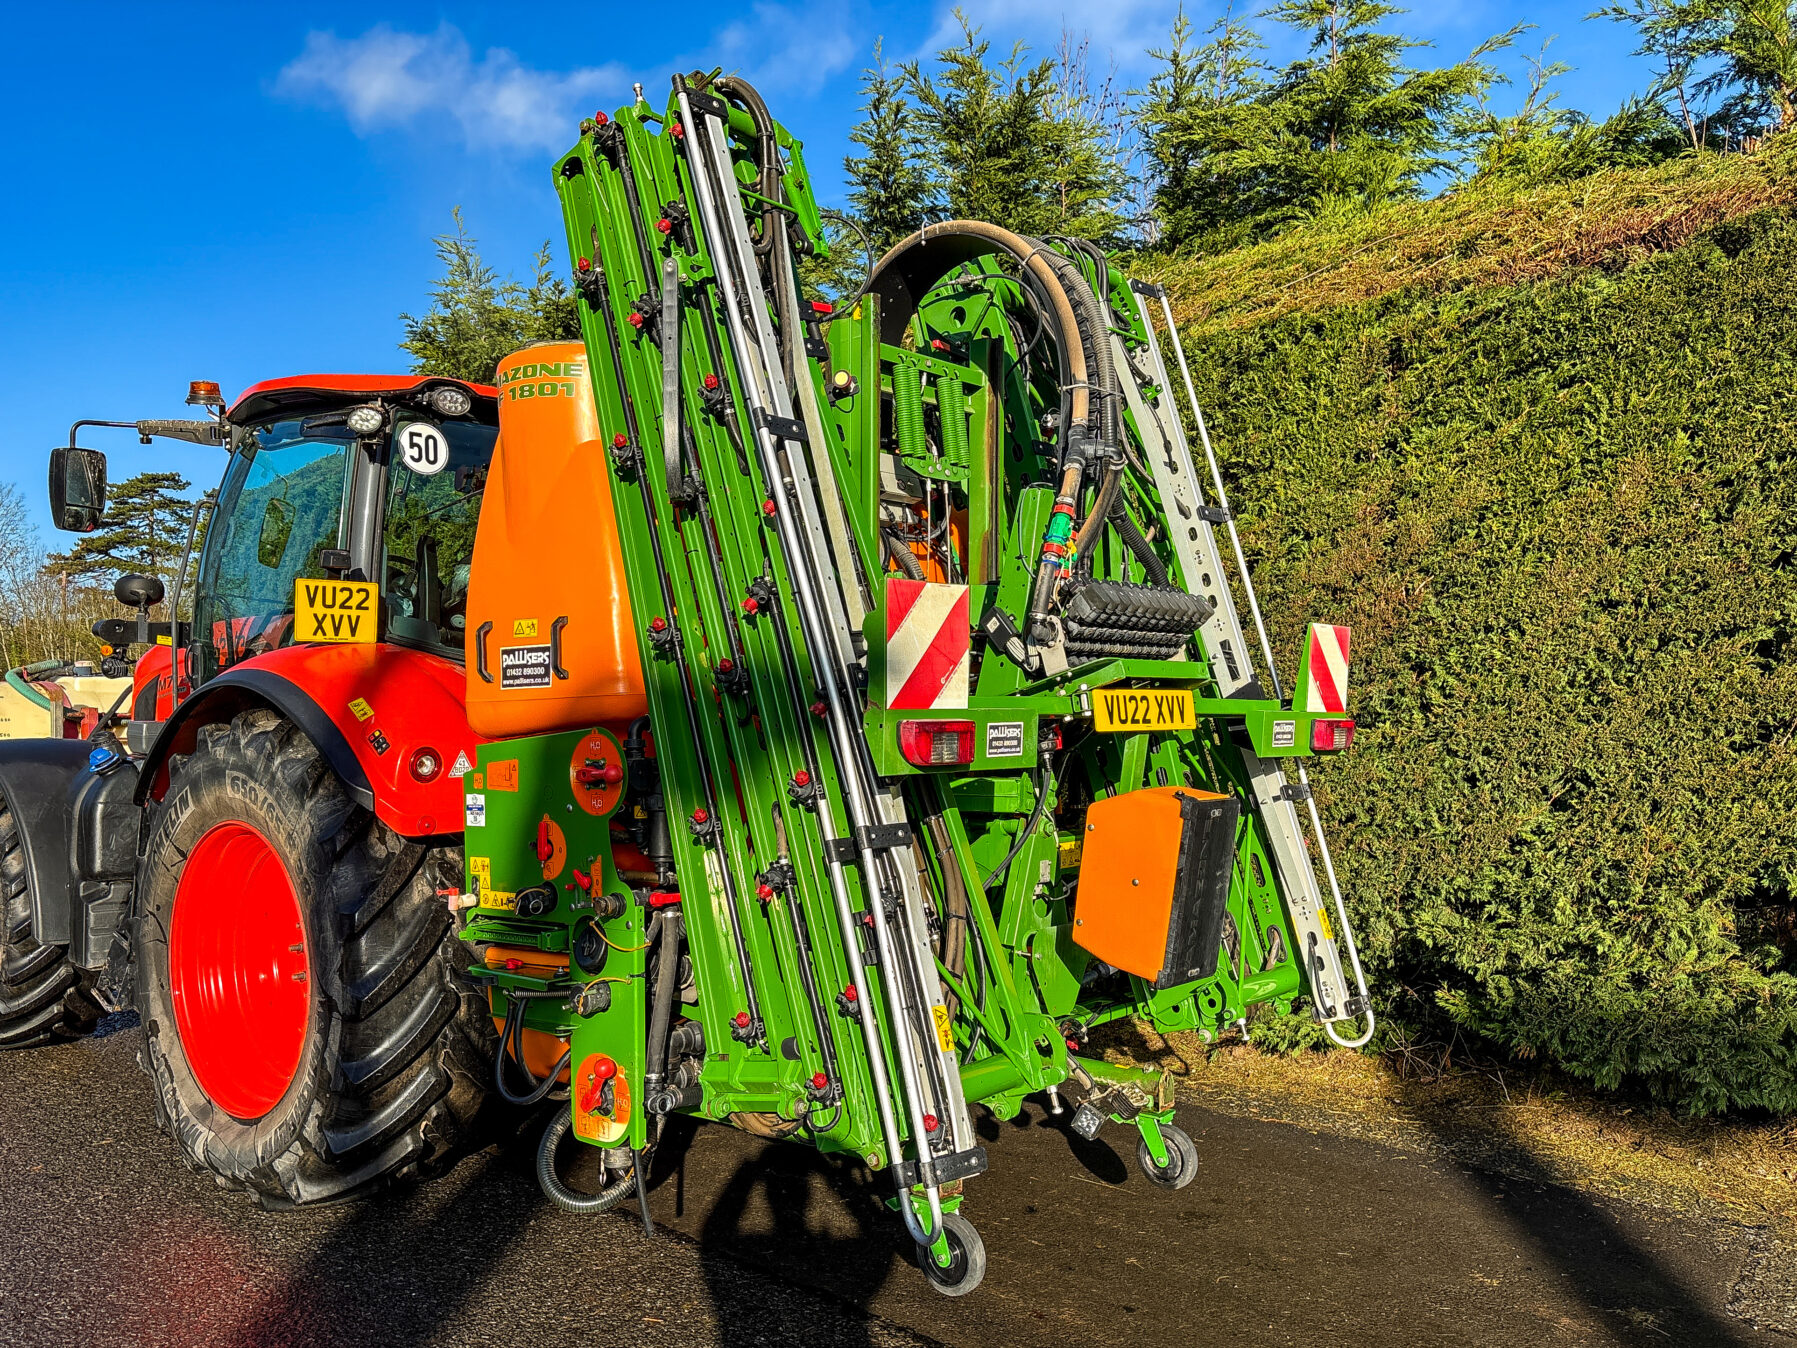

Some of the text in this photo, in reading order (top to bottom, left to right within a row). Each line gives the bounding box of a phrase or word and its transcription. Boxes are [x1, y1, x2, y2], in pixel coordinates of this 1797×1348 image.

[509, 382, 575, 401] 1801
[409, 431, 438, 465] 50
[305, 585, 369, 610] VU22
[313, 613, 360, 637] XVV
[507, 667, 545, 676] 01432 890300
[1104, 695, 1184, 724] VU22 XVV
